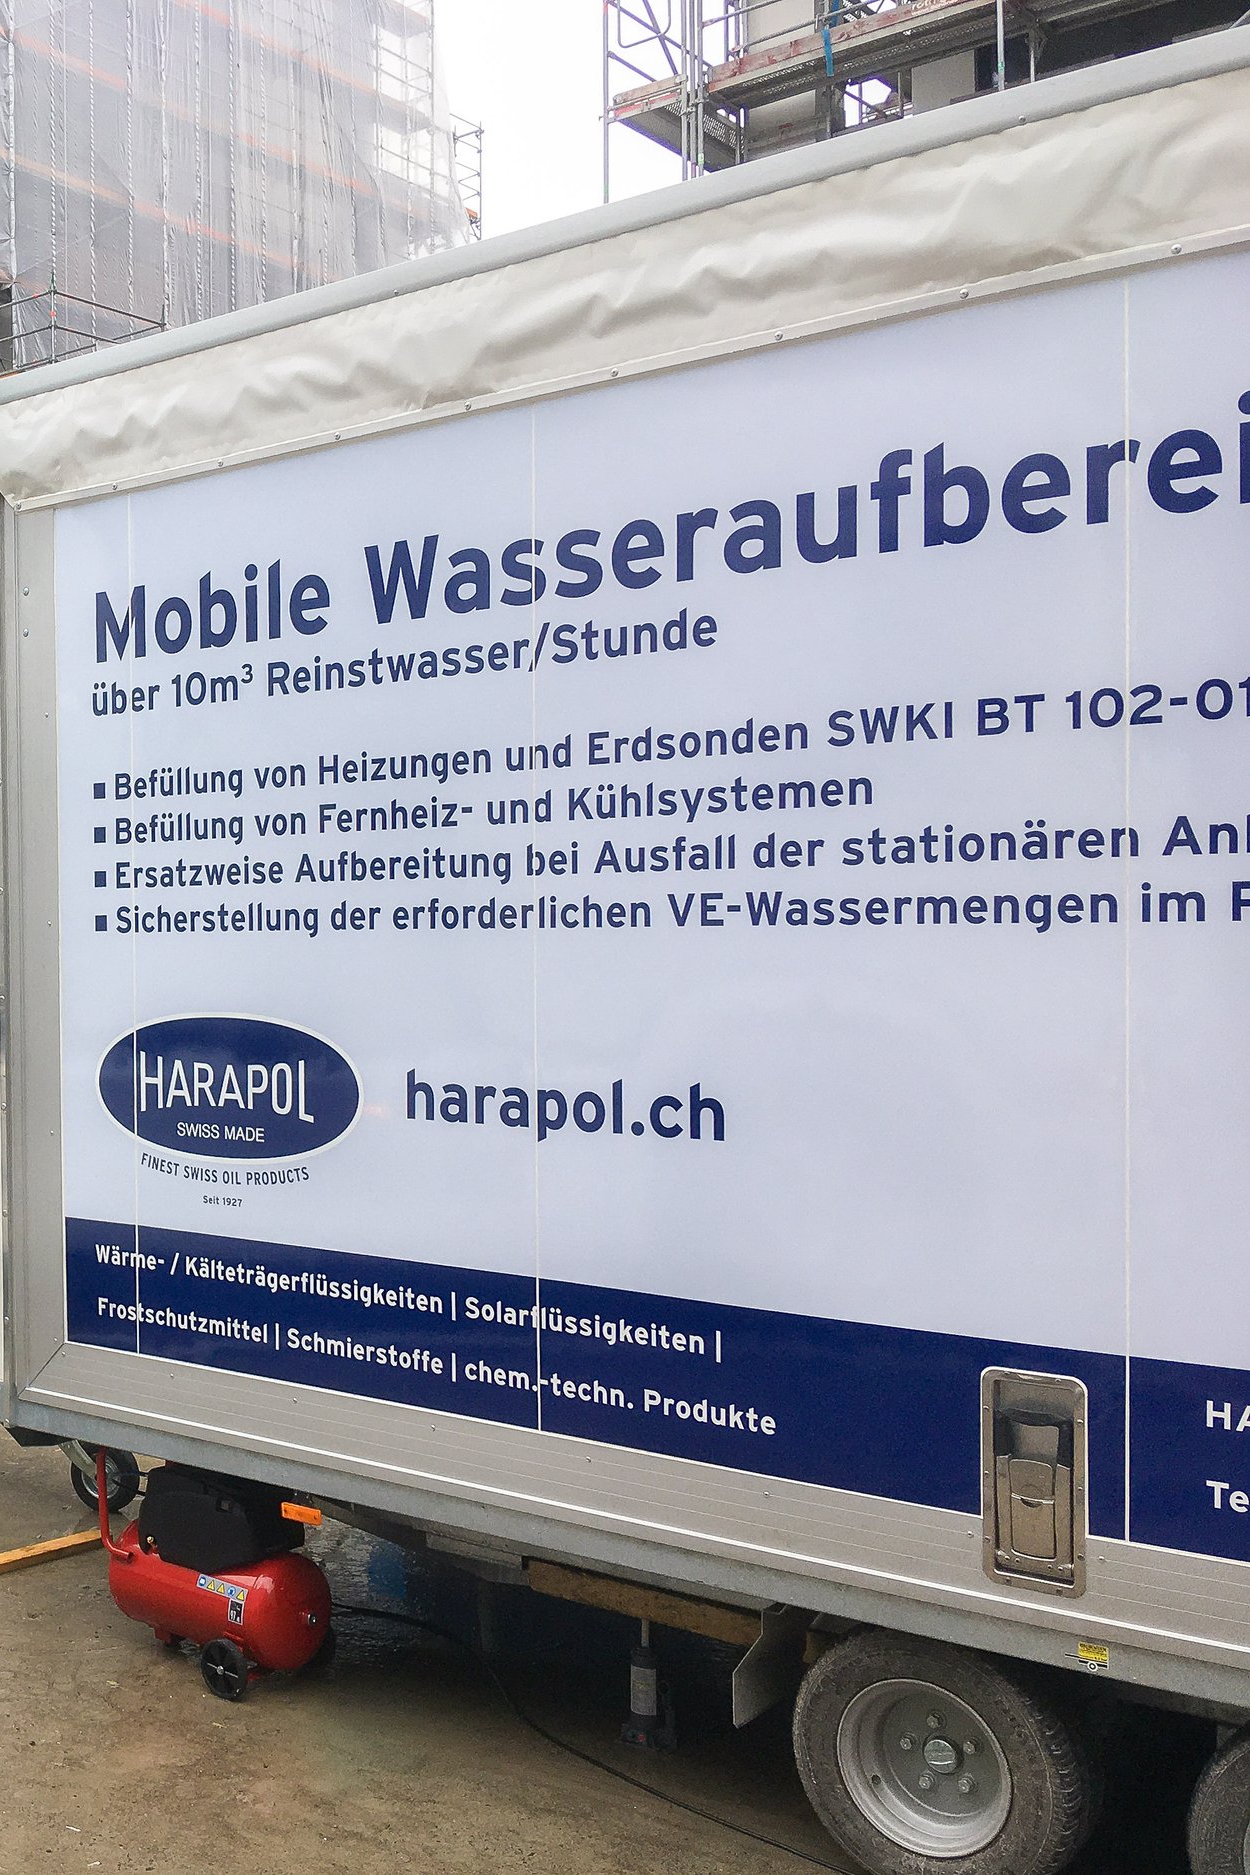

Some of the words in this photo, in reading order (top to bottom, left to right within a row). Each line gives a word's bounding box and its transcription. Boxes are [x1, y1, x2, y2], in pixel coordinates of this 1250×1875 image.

[95, 558, 331, 664] Mobile
[92, 681, 161, 717] über
[267, 607, 718, 697] Reinstwasser/Stunde
[114, 766, 243, 801] Befüllung
[253, 763, 306, 790] von
[318, 749, 492, 785] Heizungen
[505, 733, 572, 772] und
[588, 717, 808, 766] Erdsonden
[827, 701, 953, 747] SWKI
[977, 693, 1046, 737] BT
[115, 811, 244, 846] Befüllung
[253, 812, 307, 837] von
[318, 795, 473, 834] Fernheiz-
[487, 788, 552, 826] und
[568, 776, 873, 824] Kühlsystemen
[115, 855, 284, 889] Ersatzweise
[294, 846, 511, 886] Aufbereitung
[526, 840, 579, 877] bei
[593, 833, 736, 874] Ausfall
[752, 831, 825, 869] der
[841, 819, 1139, 866] stationären
[115, 901, 319, 939] Sicherstellung
[330, 900, 382, 931] der
[392, 894, 651, 930] erforderlichen
[666, 890, 1118, 934] VE-Wassermengen
[1140, 881, 1206, 923] im
[139, 1050, 315, 1124] HARAPOL
[406, 1068, 725, 1143] harapol.ch
[176, 1121, 220, 1141] SWISS
[224, 1124, 265, 1143] MADE
[140, 1152, 180, 1177] FINEST
[183, 1165, 218, 1184] SWISS
[222, 1170, 242, 1185] OIL
[246, 1166, 310, 1186] PRODUCTS
[202, 1195, 220, 1205] Seit
[222, 1197, 243, 1208] 1927
[94, 1243, 165, 1271] Wärme-
[169, 1252, 181, 1276] /
[185, 1255, 444, 1314] Kälteträgerflüssigkeiten
[464, 1296, 705, 1355] Solarflüssigkeiten
[97, 1296, 269, 1344] Frostschutzmittel
[286, 1327, 444, 1375] Schmierstoffe
[464, 1359, 635, 1410] chem.-techn.
[643, 1388, 777, 1436] Produkte
[1205, 1479, 1250, 1514] Te
